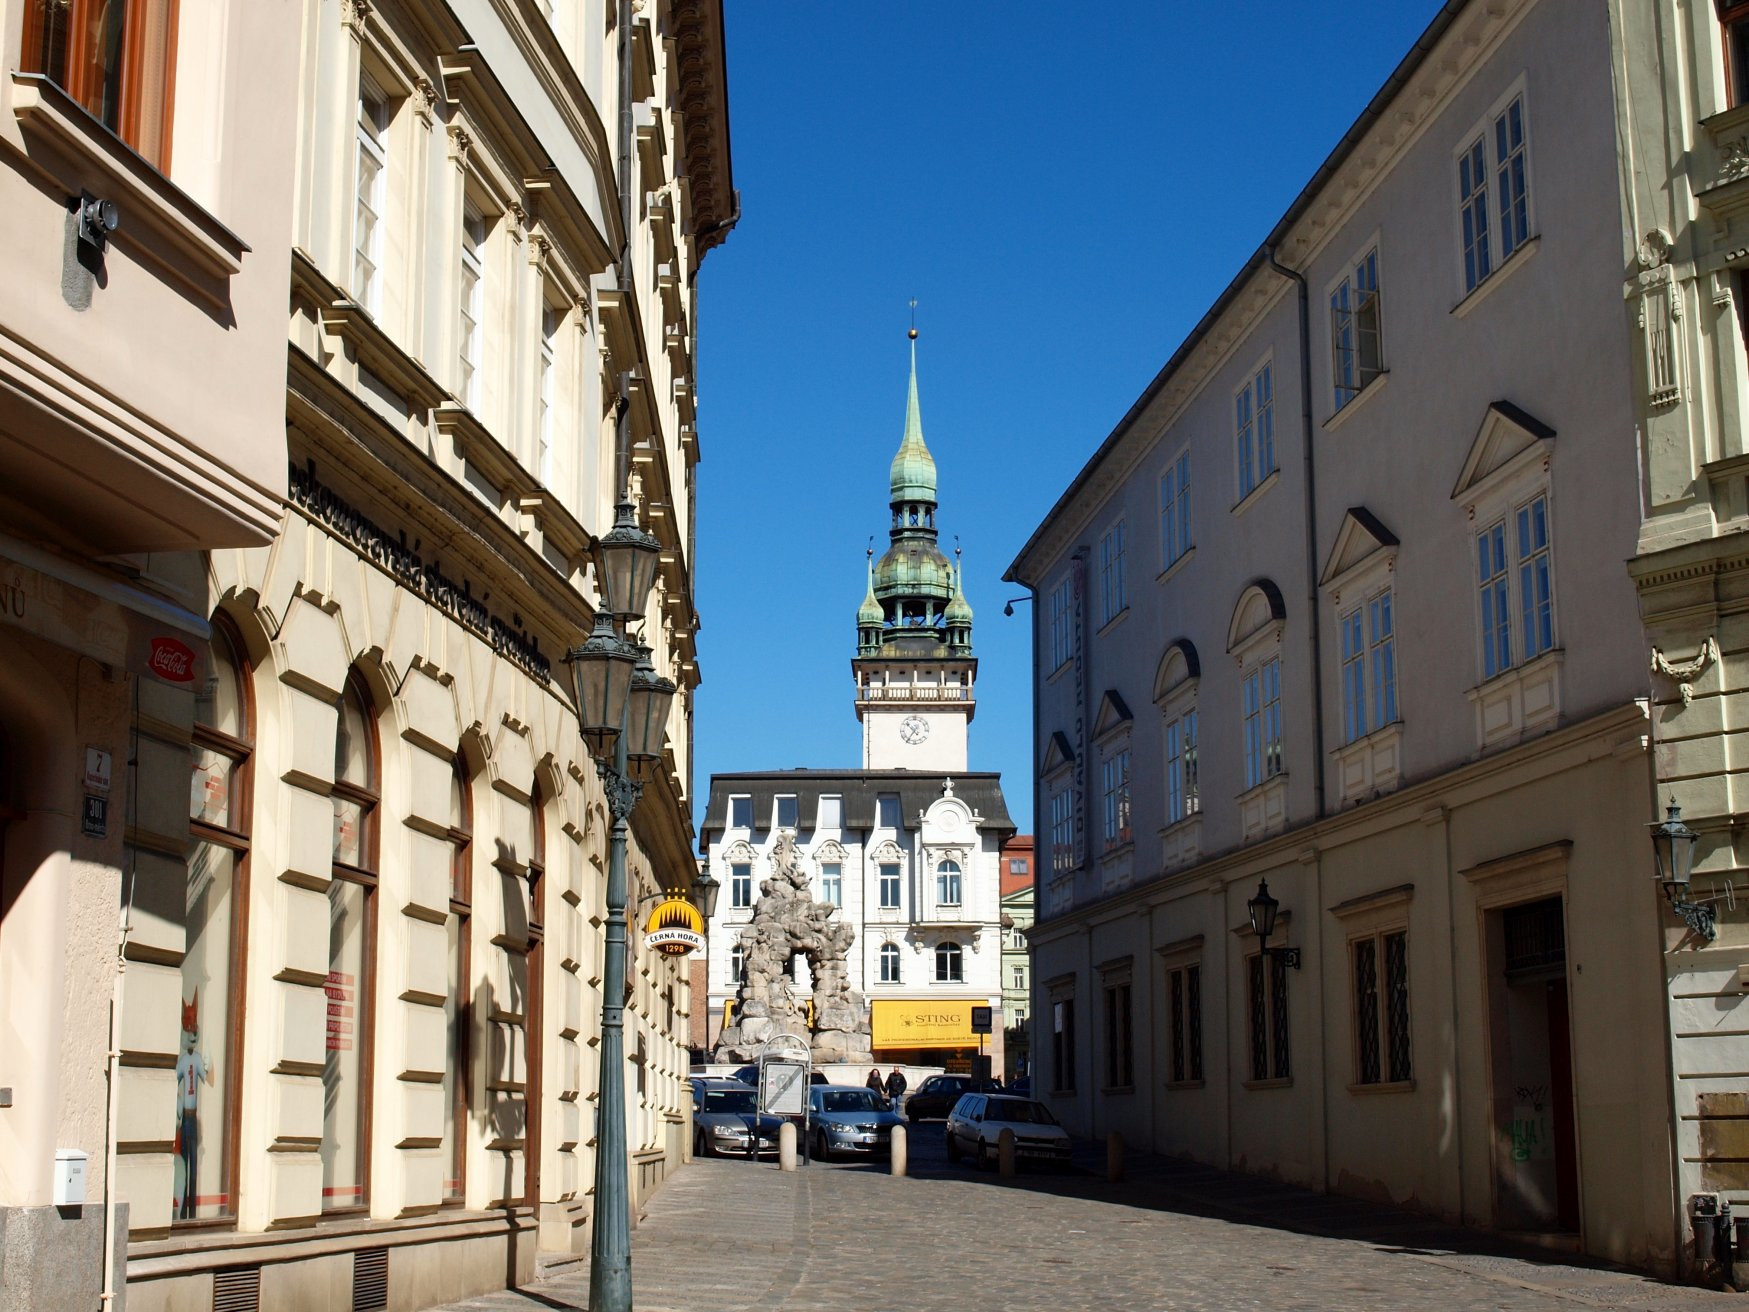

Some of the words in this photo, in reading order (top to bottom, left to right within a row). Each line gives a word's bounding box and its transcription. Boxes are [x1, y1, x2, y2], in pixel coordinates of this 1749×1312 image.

[154, 646, 188, 675] Coca-Cola
[96, 752, 103, 773] 7
[1075, 717, 1083, 833] DIVADLO
[649, 931, 675, 943] ČERNÁ
[677, 932, 699, 944] HORA
[665, 944, 684, 953] 1298
[915, 1014, 961, 1024] STING
